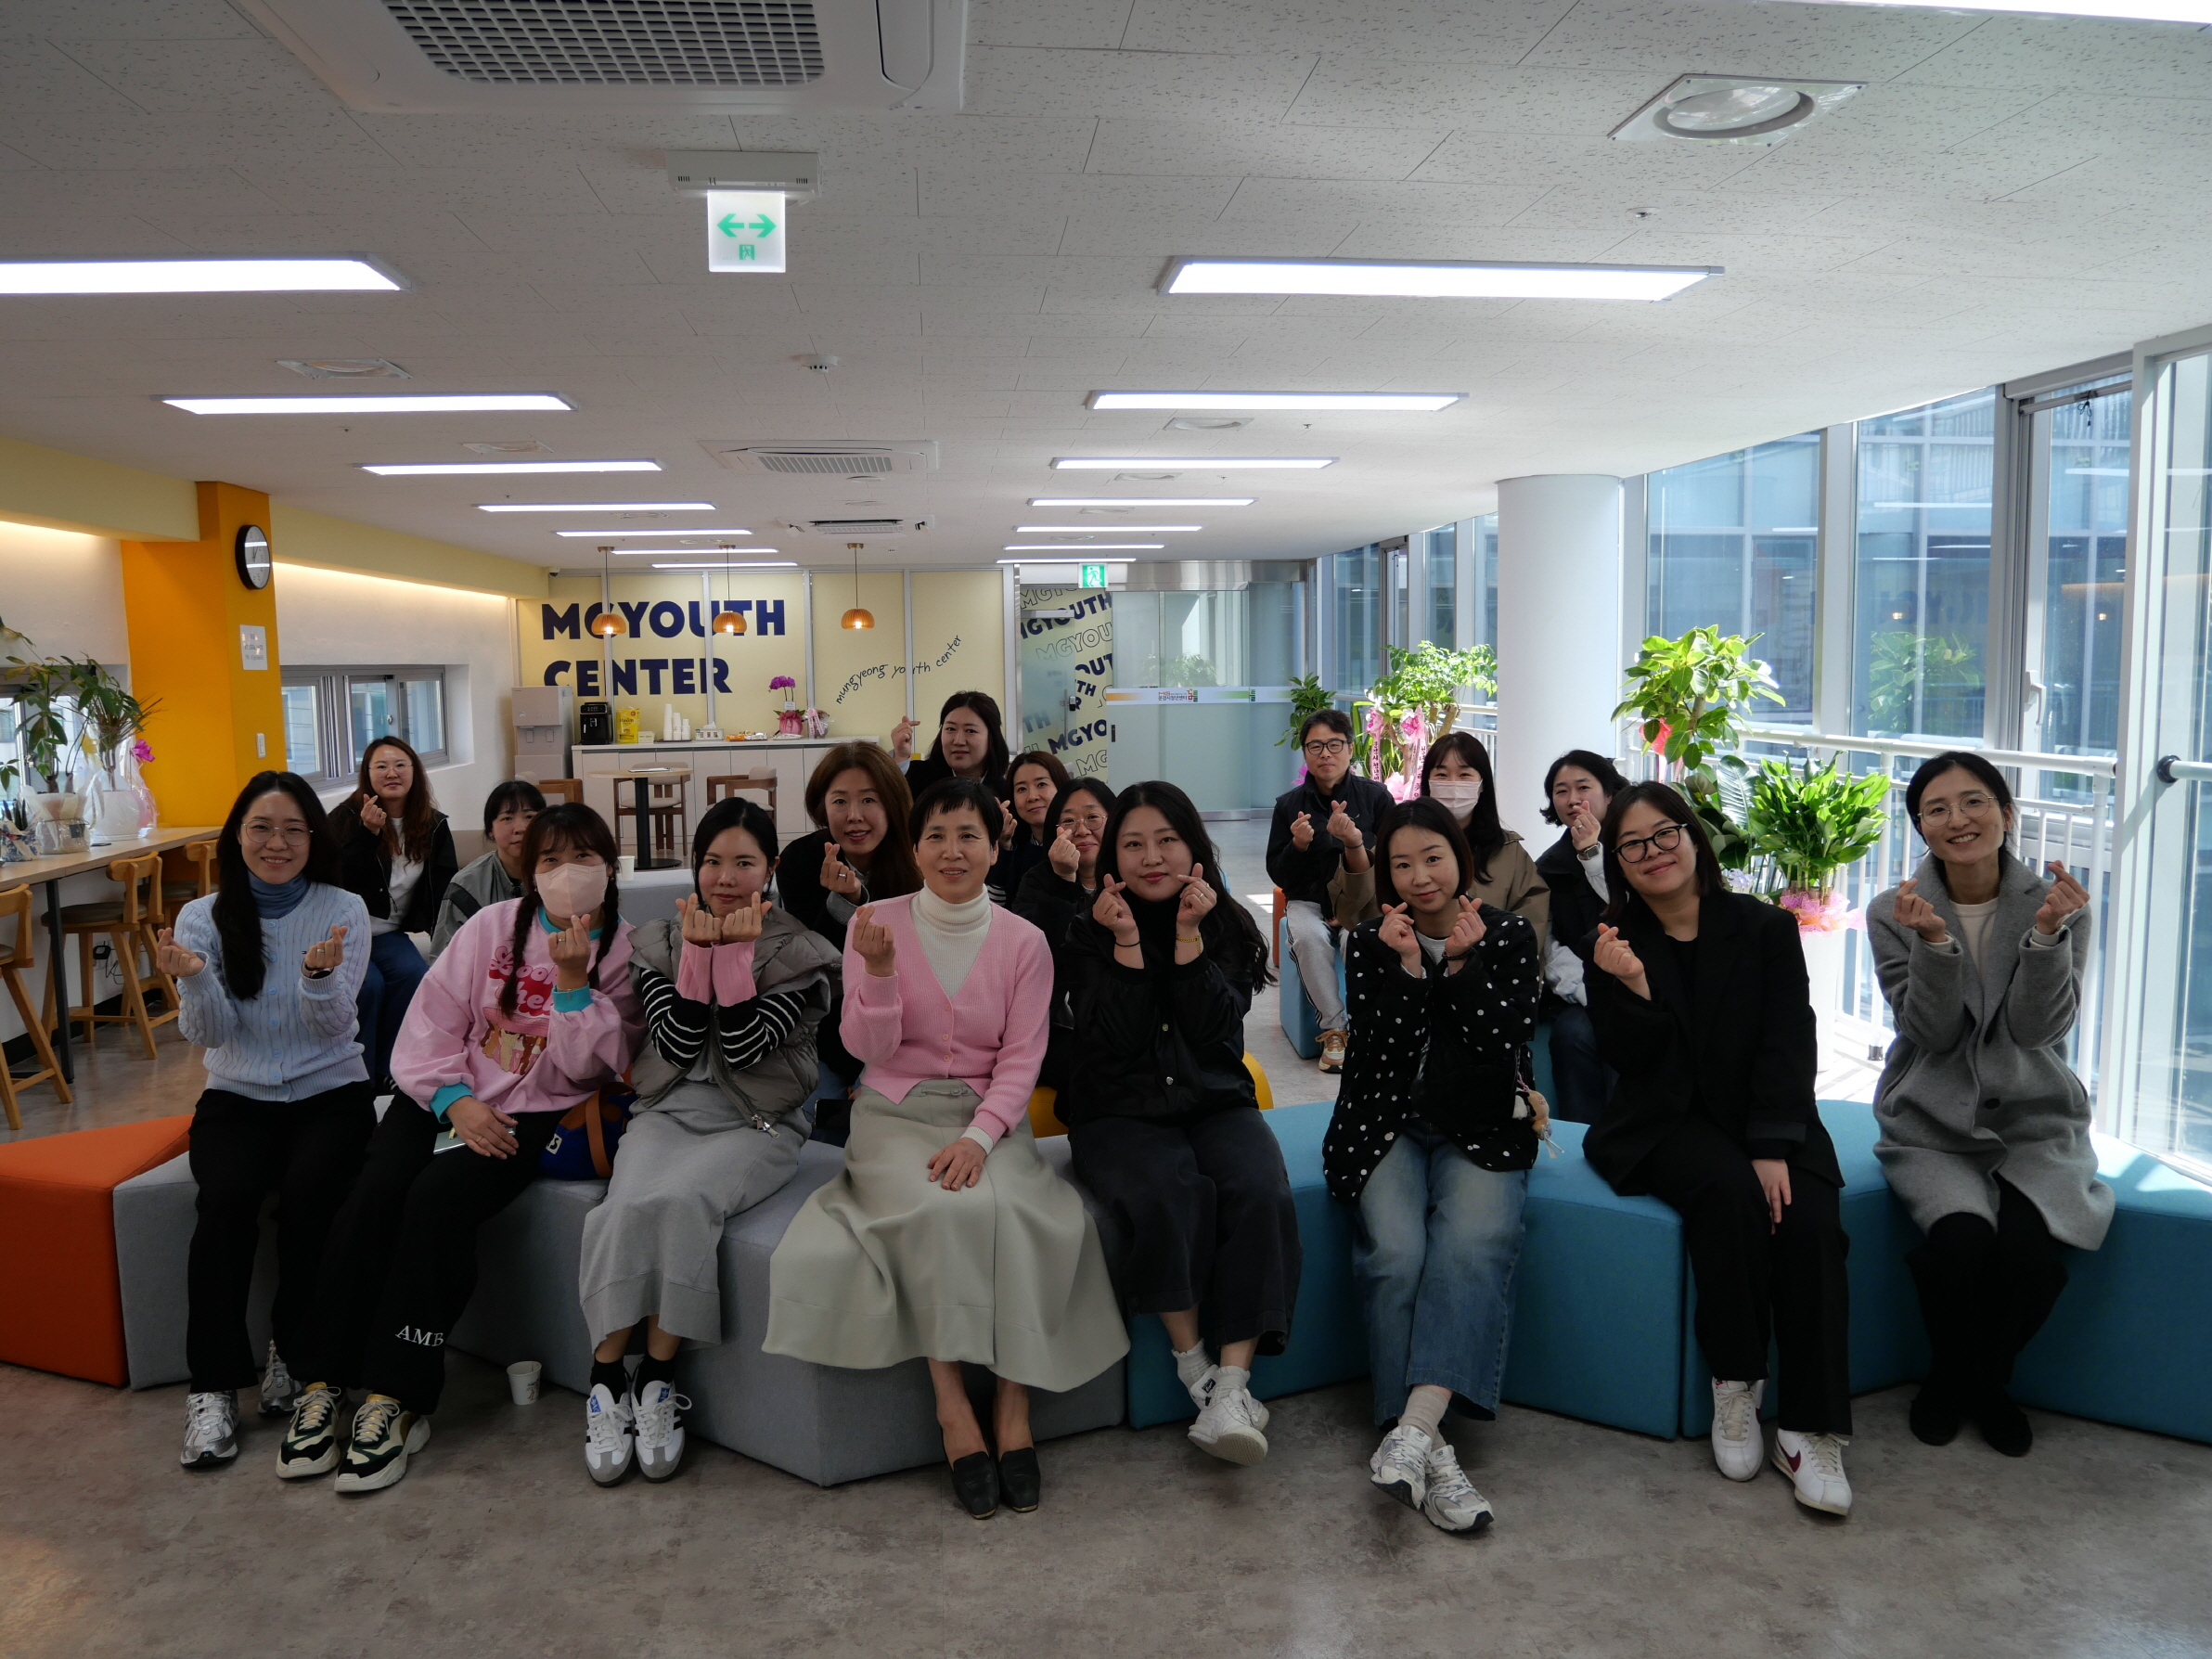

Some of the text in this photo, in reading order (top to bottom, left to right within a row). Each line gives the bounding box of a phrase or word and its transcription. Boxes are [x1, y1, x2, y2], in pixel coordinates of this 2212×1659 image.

[544, 658, 733, 697] CENTER
[836, 664, 889, 704] mungyeong
[935, 635, 961, 667] center
[1048, 719, 1107, 754] MGYO
[394, 1325, 444, 1347] AMB
